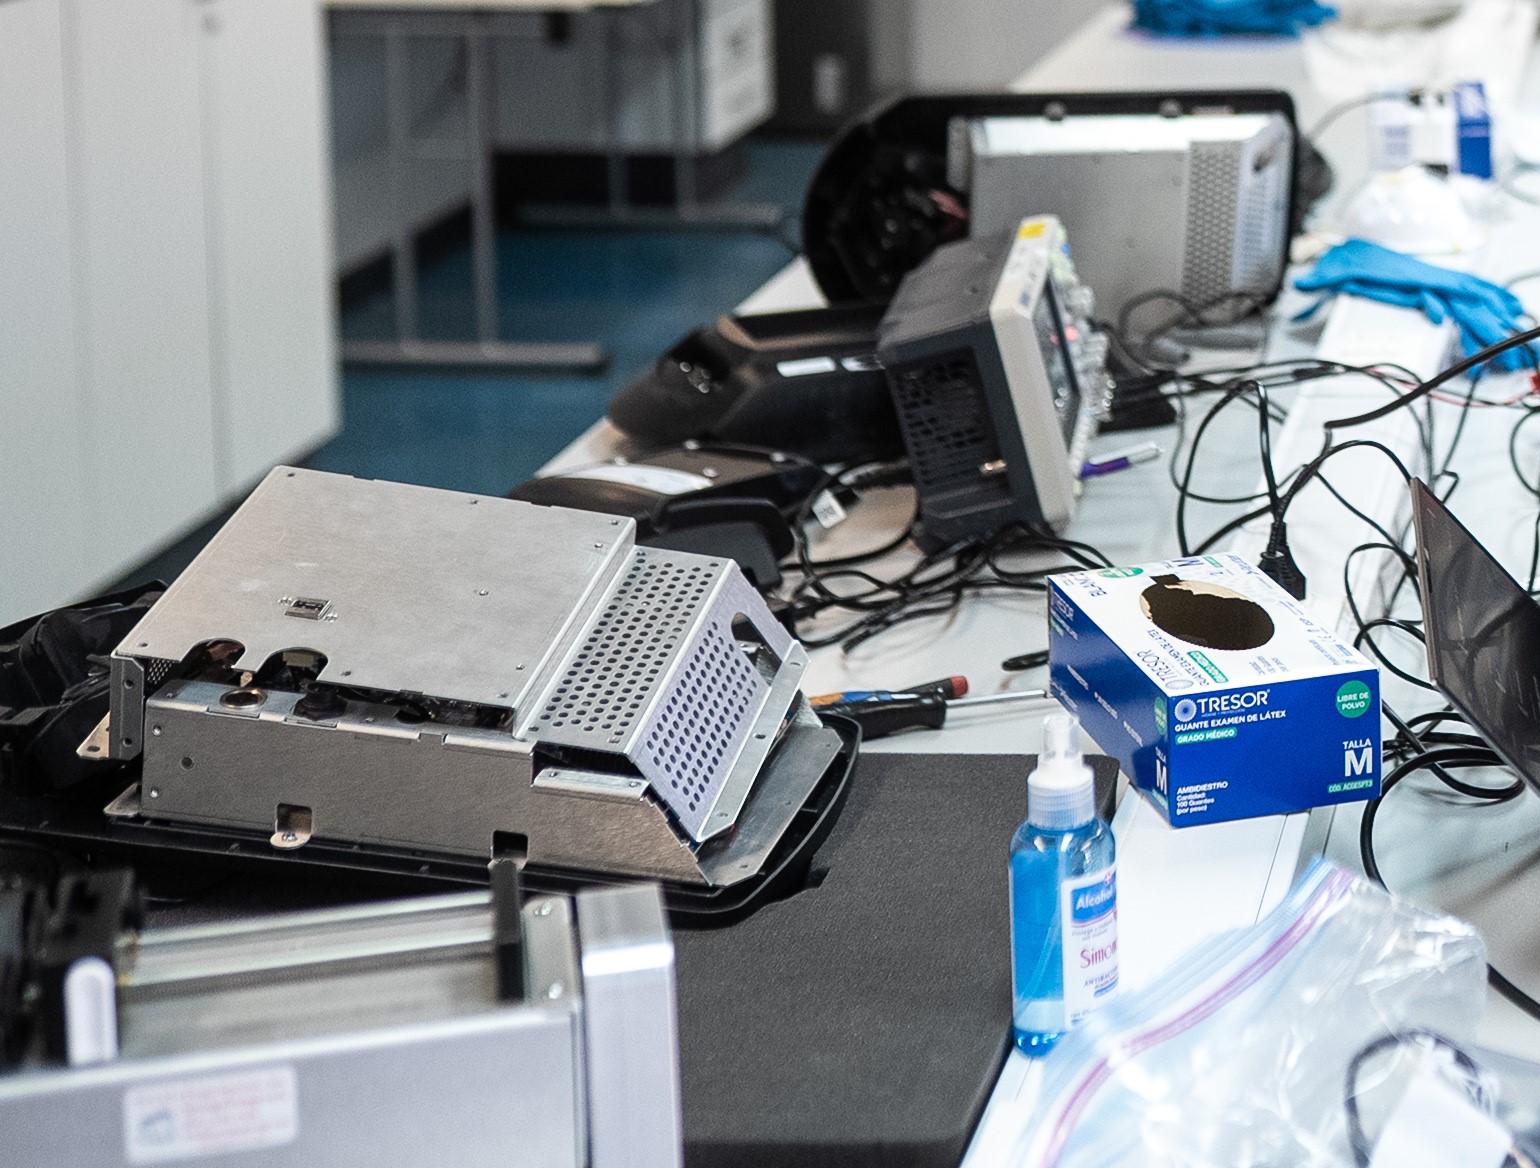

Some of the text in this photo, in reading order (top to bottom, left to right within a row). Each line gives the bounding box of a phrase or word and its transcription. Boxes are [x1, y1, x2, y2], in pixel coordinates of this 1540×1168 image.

[1137, 650, 1177, 681] TRESOR
[1197, 691, 1268, 713] TRESOR
[1337, 692, 1369, 702] LIBRE DE
[1341, 701, 1365, 710] POLVO
[1174, 709, 1286, 732] GUANTE EXAMEN DE LÁTEX
[1177, 729, 1235, 743] GRADO MÉDICO
[1342, 738, 1372, 750] TALLA
[1344, 747, 1373, 777] M
[1176, 781, 1229, 795] AMBIDIESTRO
[1188, 798, 1215, 806] Guantes
[1076, 884, 1113, 910] Alcohol
